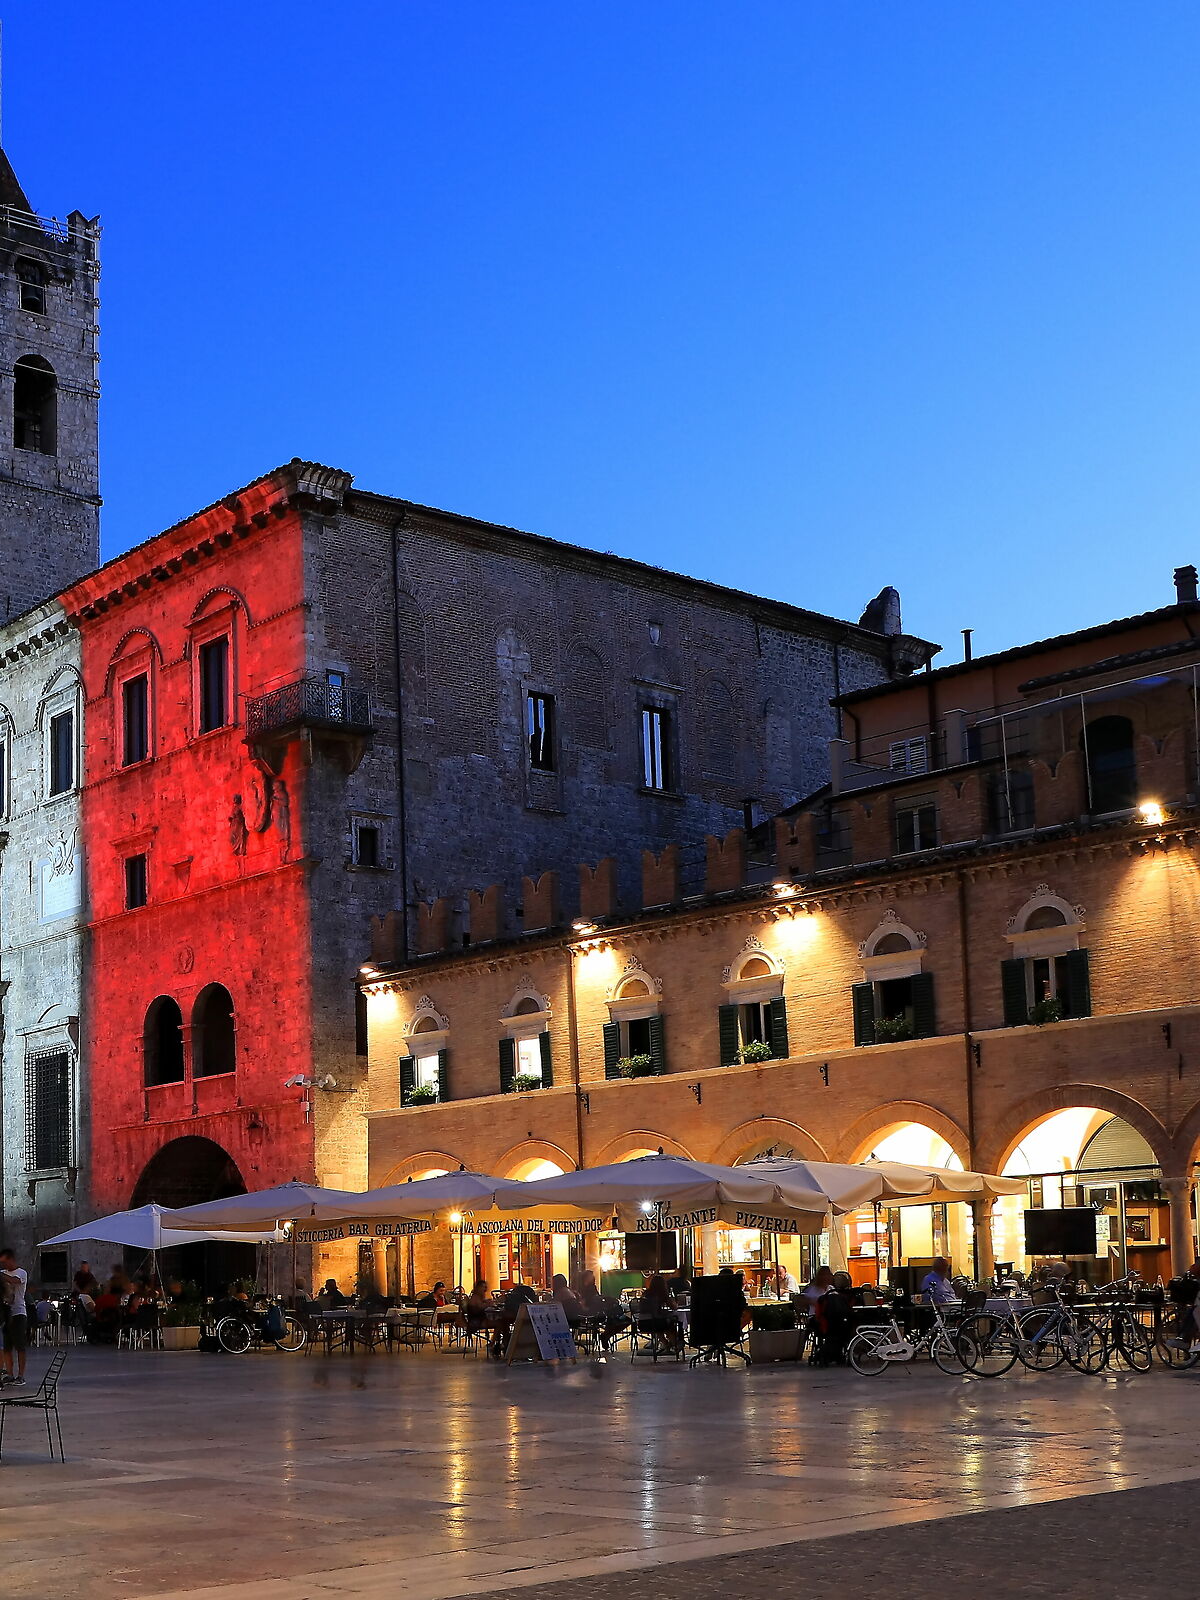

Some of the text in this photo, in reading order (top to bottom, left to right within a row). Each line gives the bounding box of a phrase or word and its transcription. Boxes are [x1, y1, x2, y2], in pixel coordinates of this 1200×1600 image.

[348, 1223, 369, 1236] BAR
[375, 1220, 432, 1236] GELATERIA
[477, 1219, 524, 1234] ASCOLANA
[527, 1219, 545, 1232] DEL
[549, 1220, 583, 1233] PICENO
[584, 1218, 603, 1231] DOP
[736, 1211, 799, 1233] PIZZERIA
